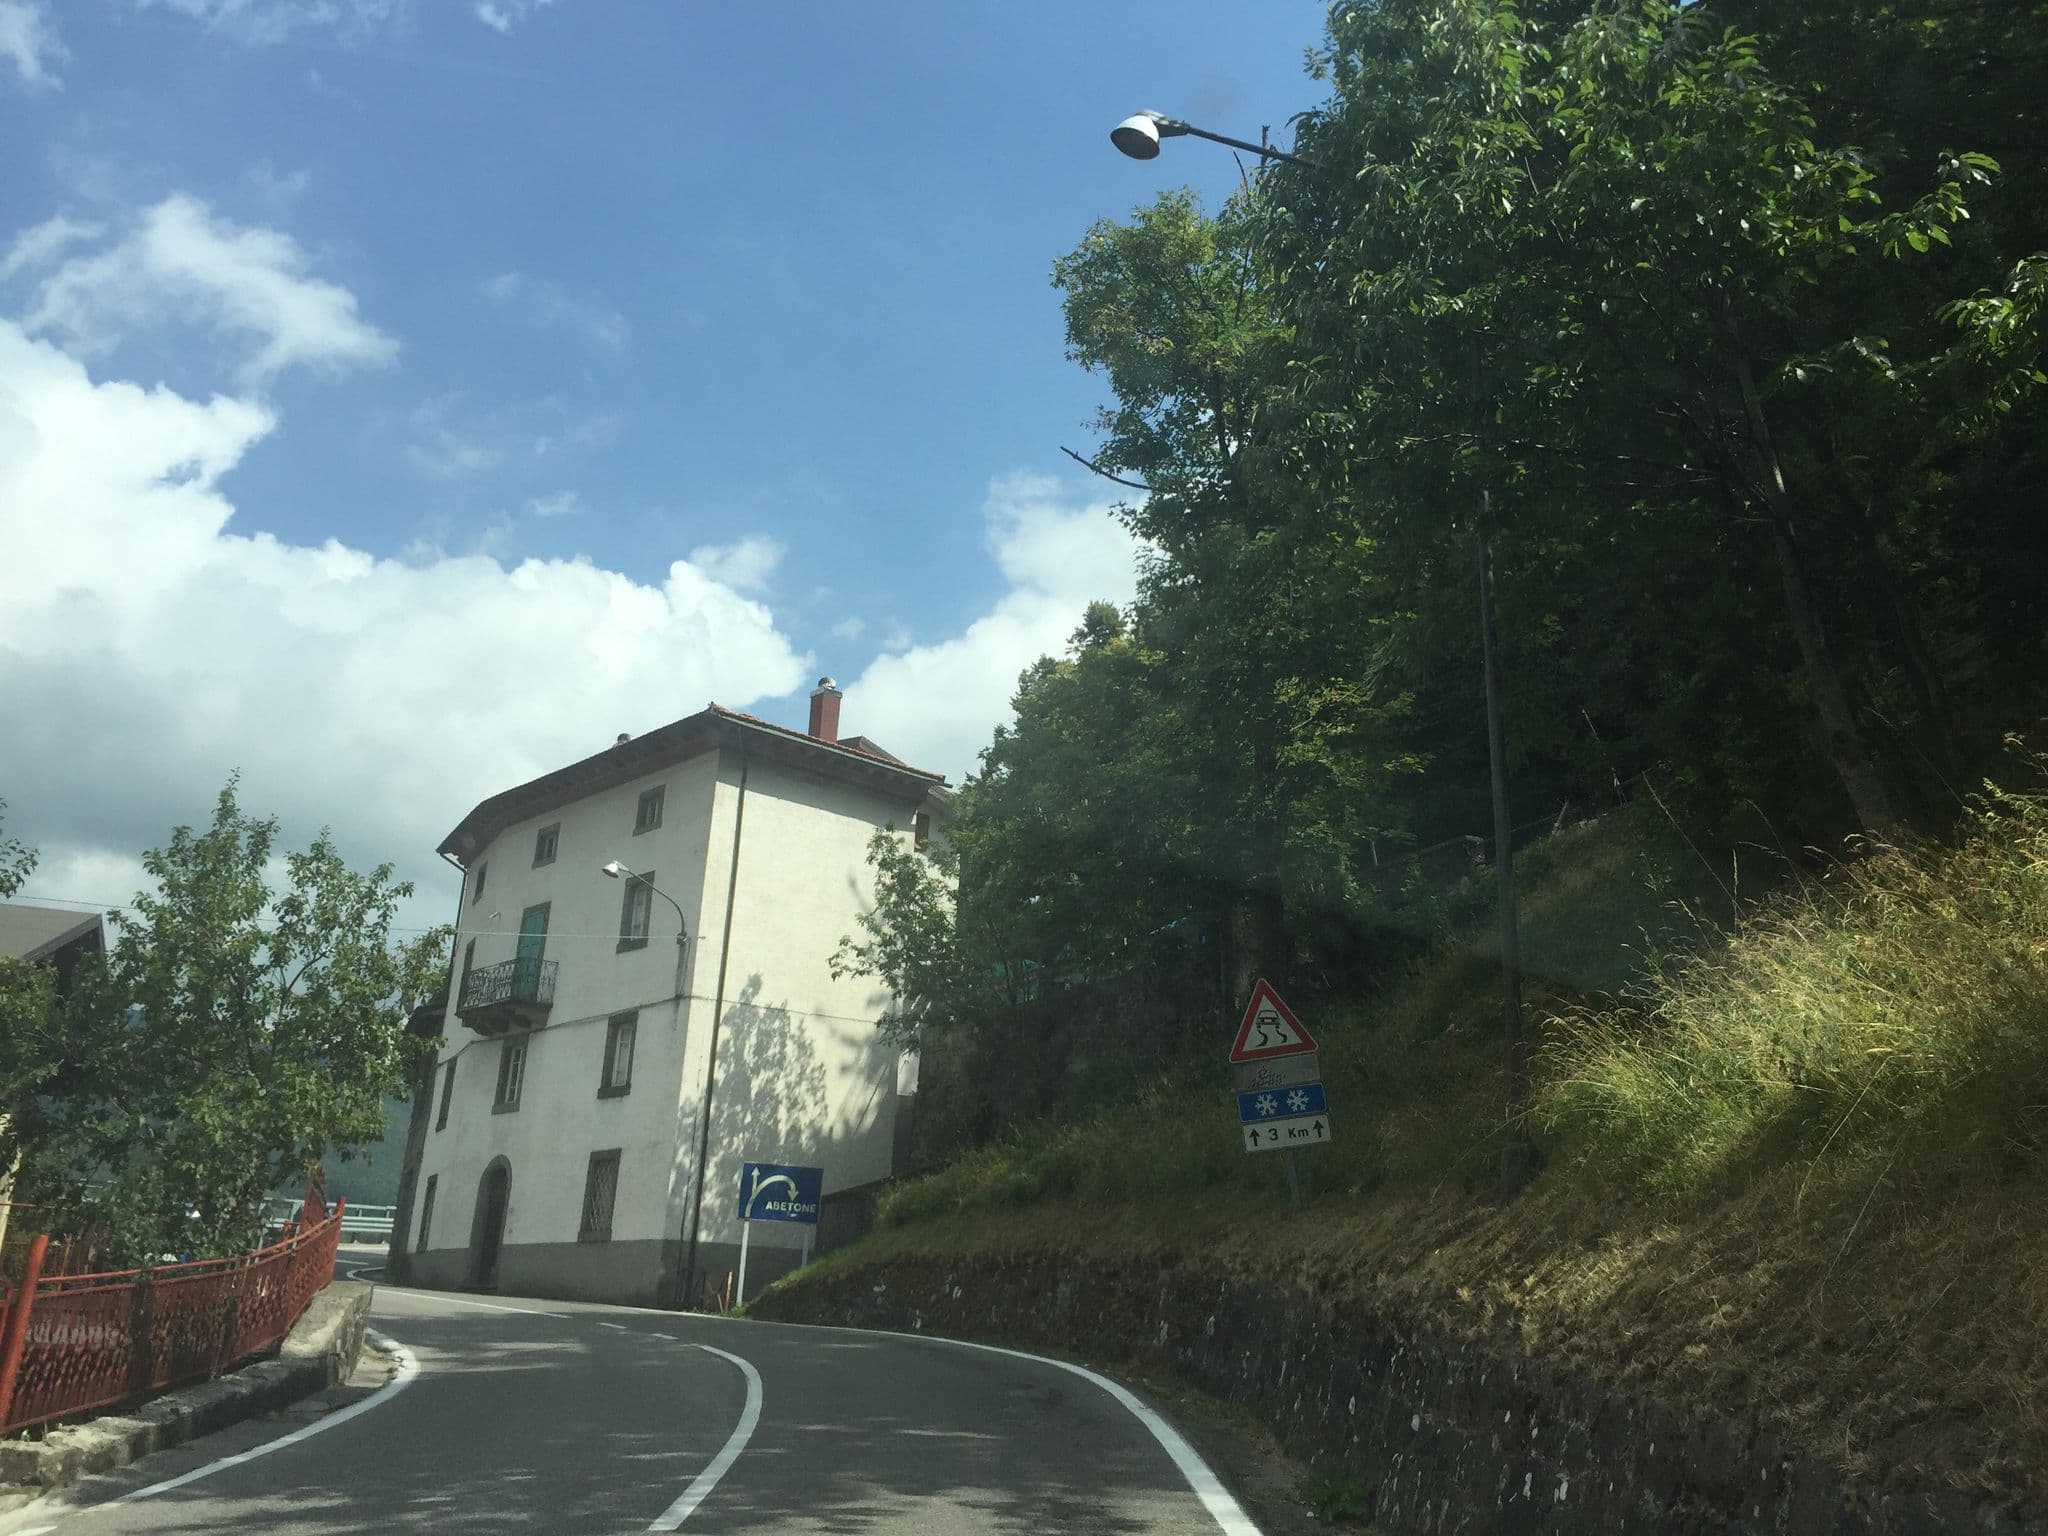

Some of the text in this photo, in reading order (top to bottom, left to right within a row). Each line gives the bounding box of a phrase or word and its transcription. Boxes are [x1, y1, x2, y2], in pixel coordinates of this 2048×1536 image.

[1268, 1127, 1309, 1141] 3 Km
[765, 1201, 816, 1213] ABETONE
